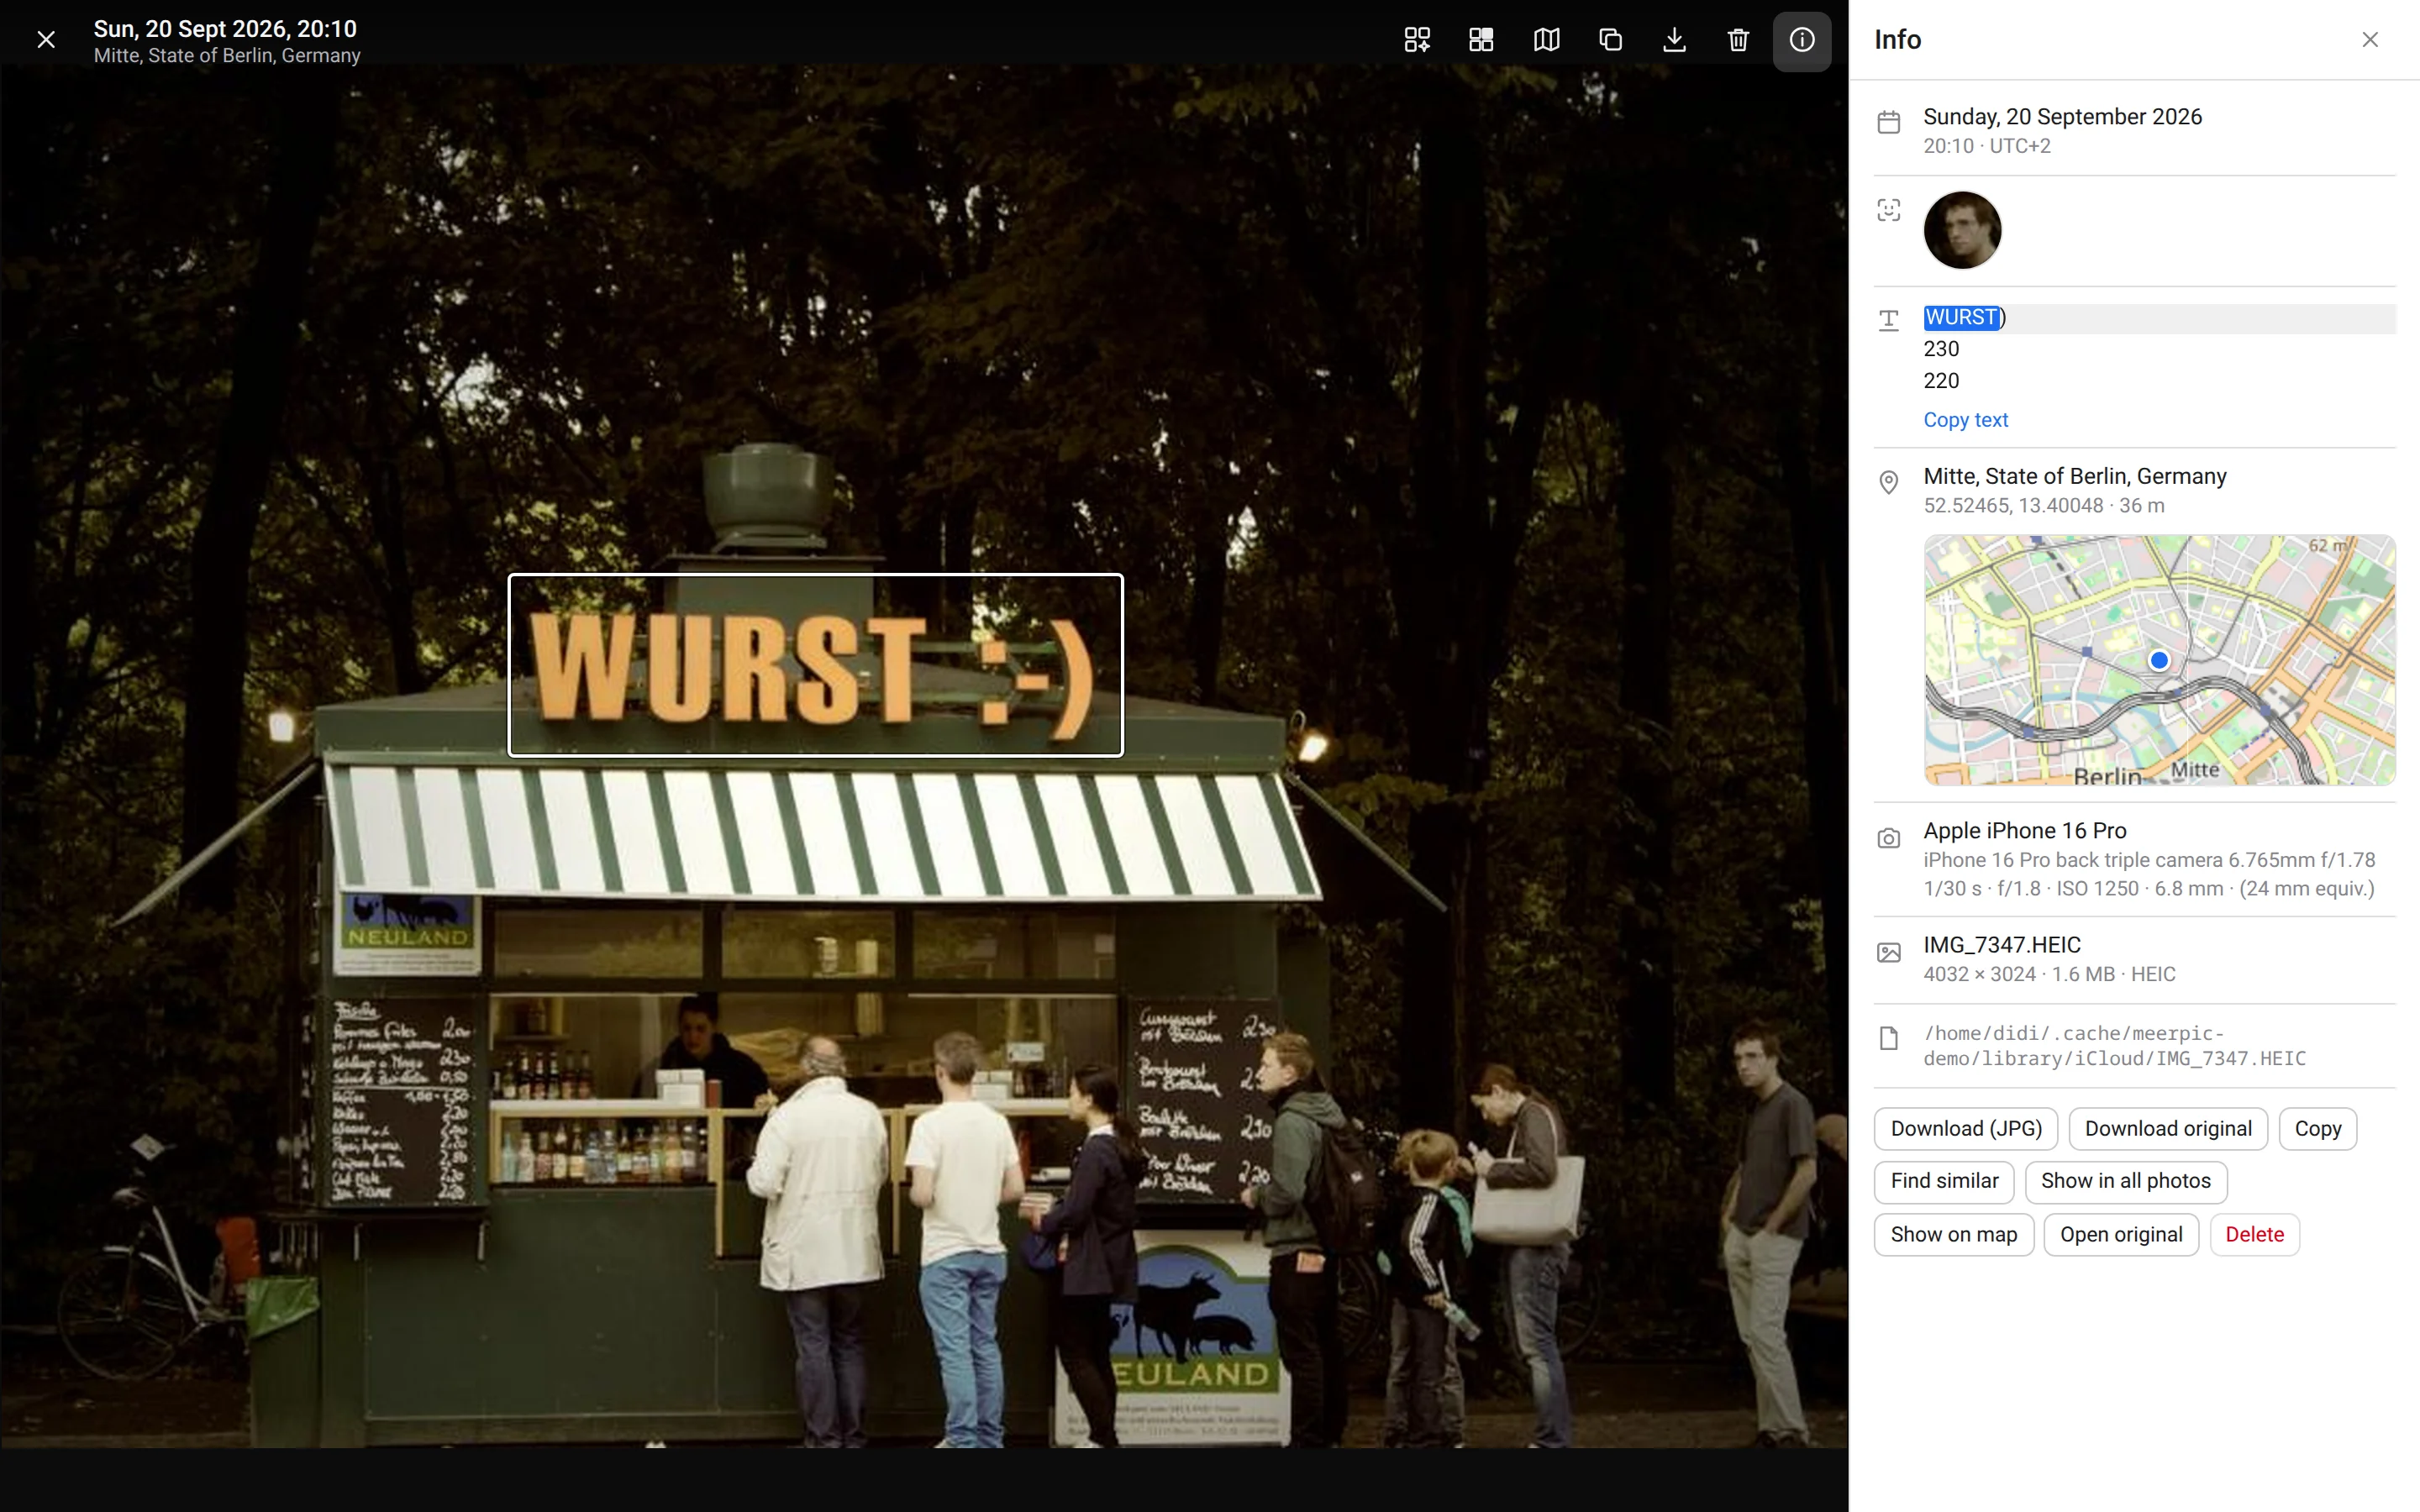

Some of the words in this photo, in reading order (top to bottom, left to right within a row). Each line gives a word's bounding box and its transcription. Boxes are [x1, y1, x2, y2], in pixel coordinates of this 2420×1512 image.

[1876, 28, 1922, 50] Info
[1923, 107, 2001, 130] Sunday,
[2006, 108, 2032, 126] 20
[2037, 107, 2148, 130] September
[2152, 108, 2203, 126] 2026
[1923, 137, 1975, 154] 20:10
[1991, 138, 2051, 154] UTC+2
[1923, 339, 1960, 357] 230
[1923, 371, 1960, 389] 220
[1923, 411, 1970, 432] Copy
[1974, 412, 2009, 428] text
[1924, 467, 1981, 488] Mitte,
[1986, 467, 2039, 486] State
[2044, 465, 2065, 485] of
[2070, 466, 2132, 488] Berlin,
[2137, 467, 2228, 490] Germany
[1924, 496, 2013, 516] 52.52465,
[2019, 496, 2104, 513] 13.40048
[2119, 496, 2143, 513] 36
[2148, 501, 2165, 513] m
[2308, 538, 2328, 553] 62
[530, 613, 926, 725] WURST
[2074, 767, 2142, 785] Berlin
[2170, 761, 2219, 778] Mitte
[1923, 821, 1981, 844] Apple
[1987, 821, 2056, 839] iPhone
[2062, 822, 2087, 839] 16
[2093, 822, 2128, 839] Pro
[1924, 851, 1986, 868] iPhone
[1992, 852, 2014, 868] 16
[2020, 852, 2050, 868] Pro
[2056, 851, 2100, 868] back
[2104, 851, 2150, 872] triple
[2155, 855, 2223, 868] camera
[2228, 852, 2315, 868] 6.765mm
[2321, 851, 2376, 869] f/1.78
[1924, 879, 1966, 898] 1/30
[1971, 884, 1982, 896] s
[1997, 879, 2041, 898] f/1.8
[2058, 879, 2088, 896] ISO
[2094, 879, 2139, 896] 1250
[2155, 879, 2183, 896] 6.8
[2189, 884, 2223, 896] mm
[2240, 879, 2270, 900] (24
[2275, 884, 2310, 896] mm
[2315, 879, 2375, 900] equiv.)
[348, 929, 468, 946] NEULAND
[1924, 936, 2081, 955] IMG_7347.HEIC
[1923, 965, 1970, 982] 4032
[1991, 965, 2037, 982] 3024
[2053, 966, 2080, 982] 1.6
[2086, 966, 2116, 982] MB
[2132, 966, 2176, 982] HEIC
[1925, 1024, 2223, 1046] /home/didi/.cache/meerpic-
[1923, 1049, 2307, 1071] demo/library/iCloud/IMG_7347.HEIC
[1891, 1119, 1984, 1137] Download
[1990, 1118, 2043, 1142] (JPG)
[2086, 1119, 2178, 1137] Download
[2184, 1119, 2252, 1142] original
[2295, 1120, 2343, 1142] Copy
[1891, 1171, 1931, 1189] Find
[1936, 1171, 2000, 1189] similar
[2041, 1171, 2094, 1189] Show
[2099, 1172, 2115, 1189] in
[2120, 1171, 2141, 1189] all
[2147, 1171, 2212, 1193] photos
[1891, 1225, 1944, 1242] Show
[1948, 1229, 1971, 1242] on
[1977, 1229, 2018, 1247] map
[2060, 1226, 2109, 1247] Open
[2114, 1225, 2183, 1247] original
[2226, 1225, 2285, 1243] Delete
[1114, 1362, 1269, 1386] EULAND
